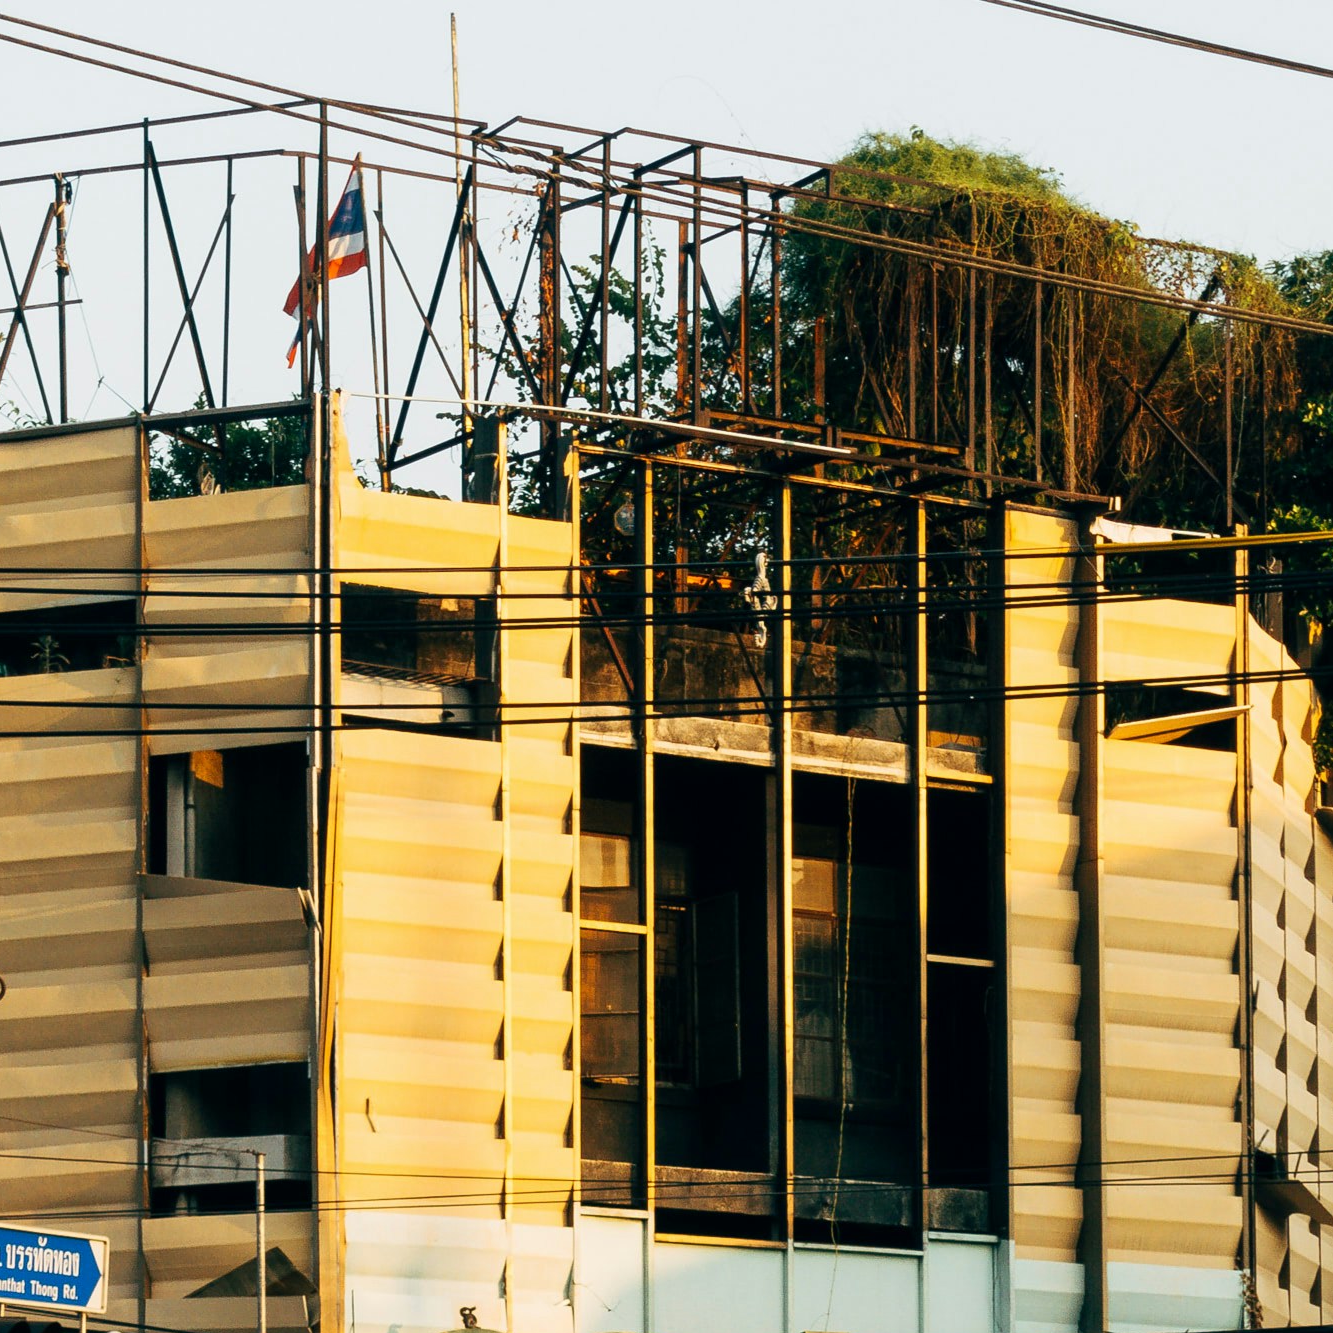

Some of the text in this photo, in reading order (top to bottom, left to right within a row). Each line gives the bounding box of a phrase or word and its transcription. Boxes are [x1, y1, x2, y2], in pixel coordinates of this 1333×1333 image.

[5, 1236, 80, 1277] บรรทัดทอง
[30, 1280, 59, 1301] Thong
[63, 1284, 79, 1300] Rd.
